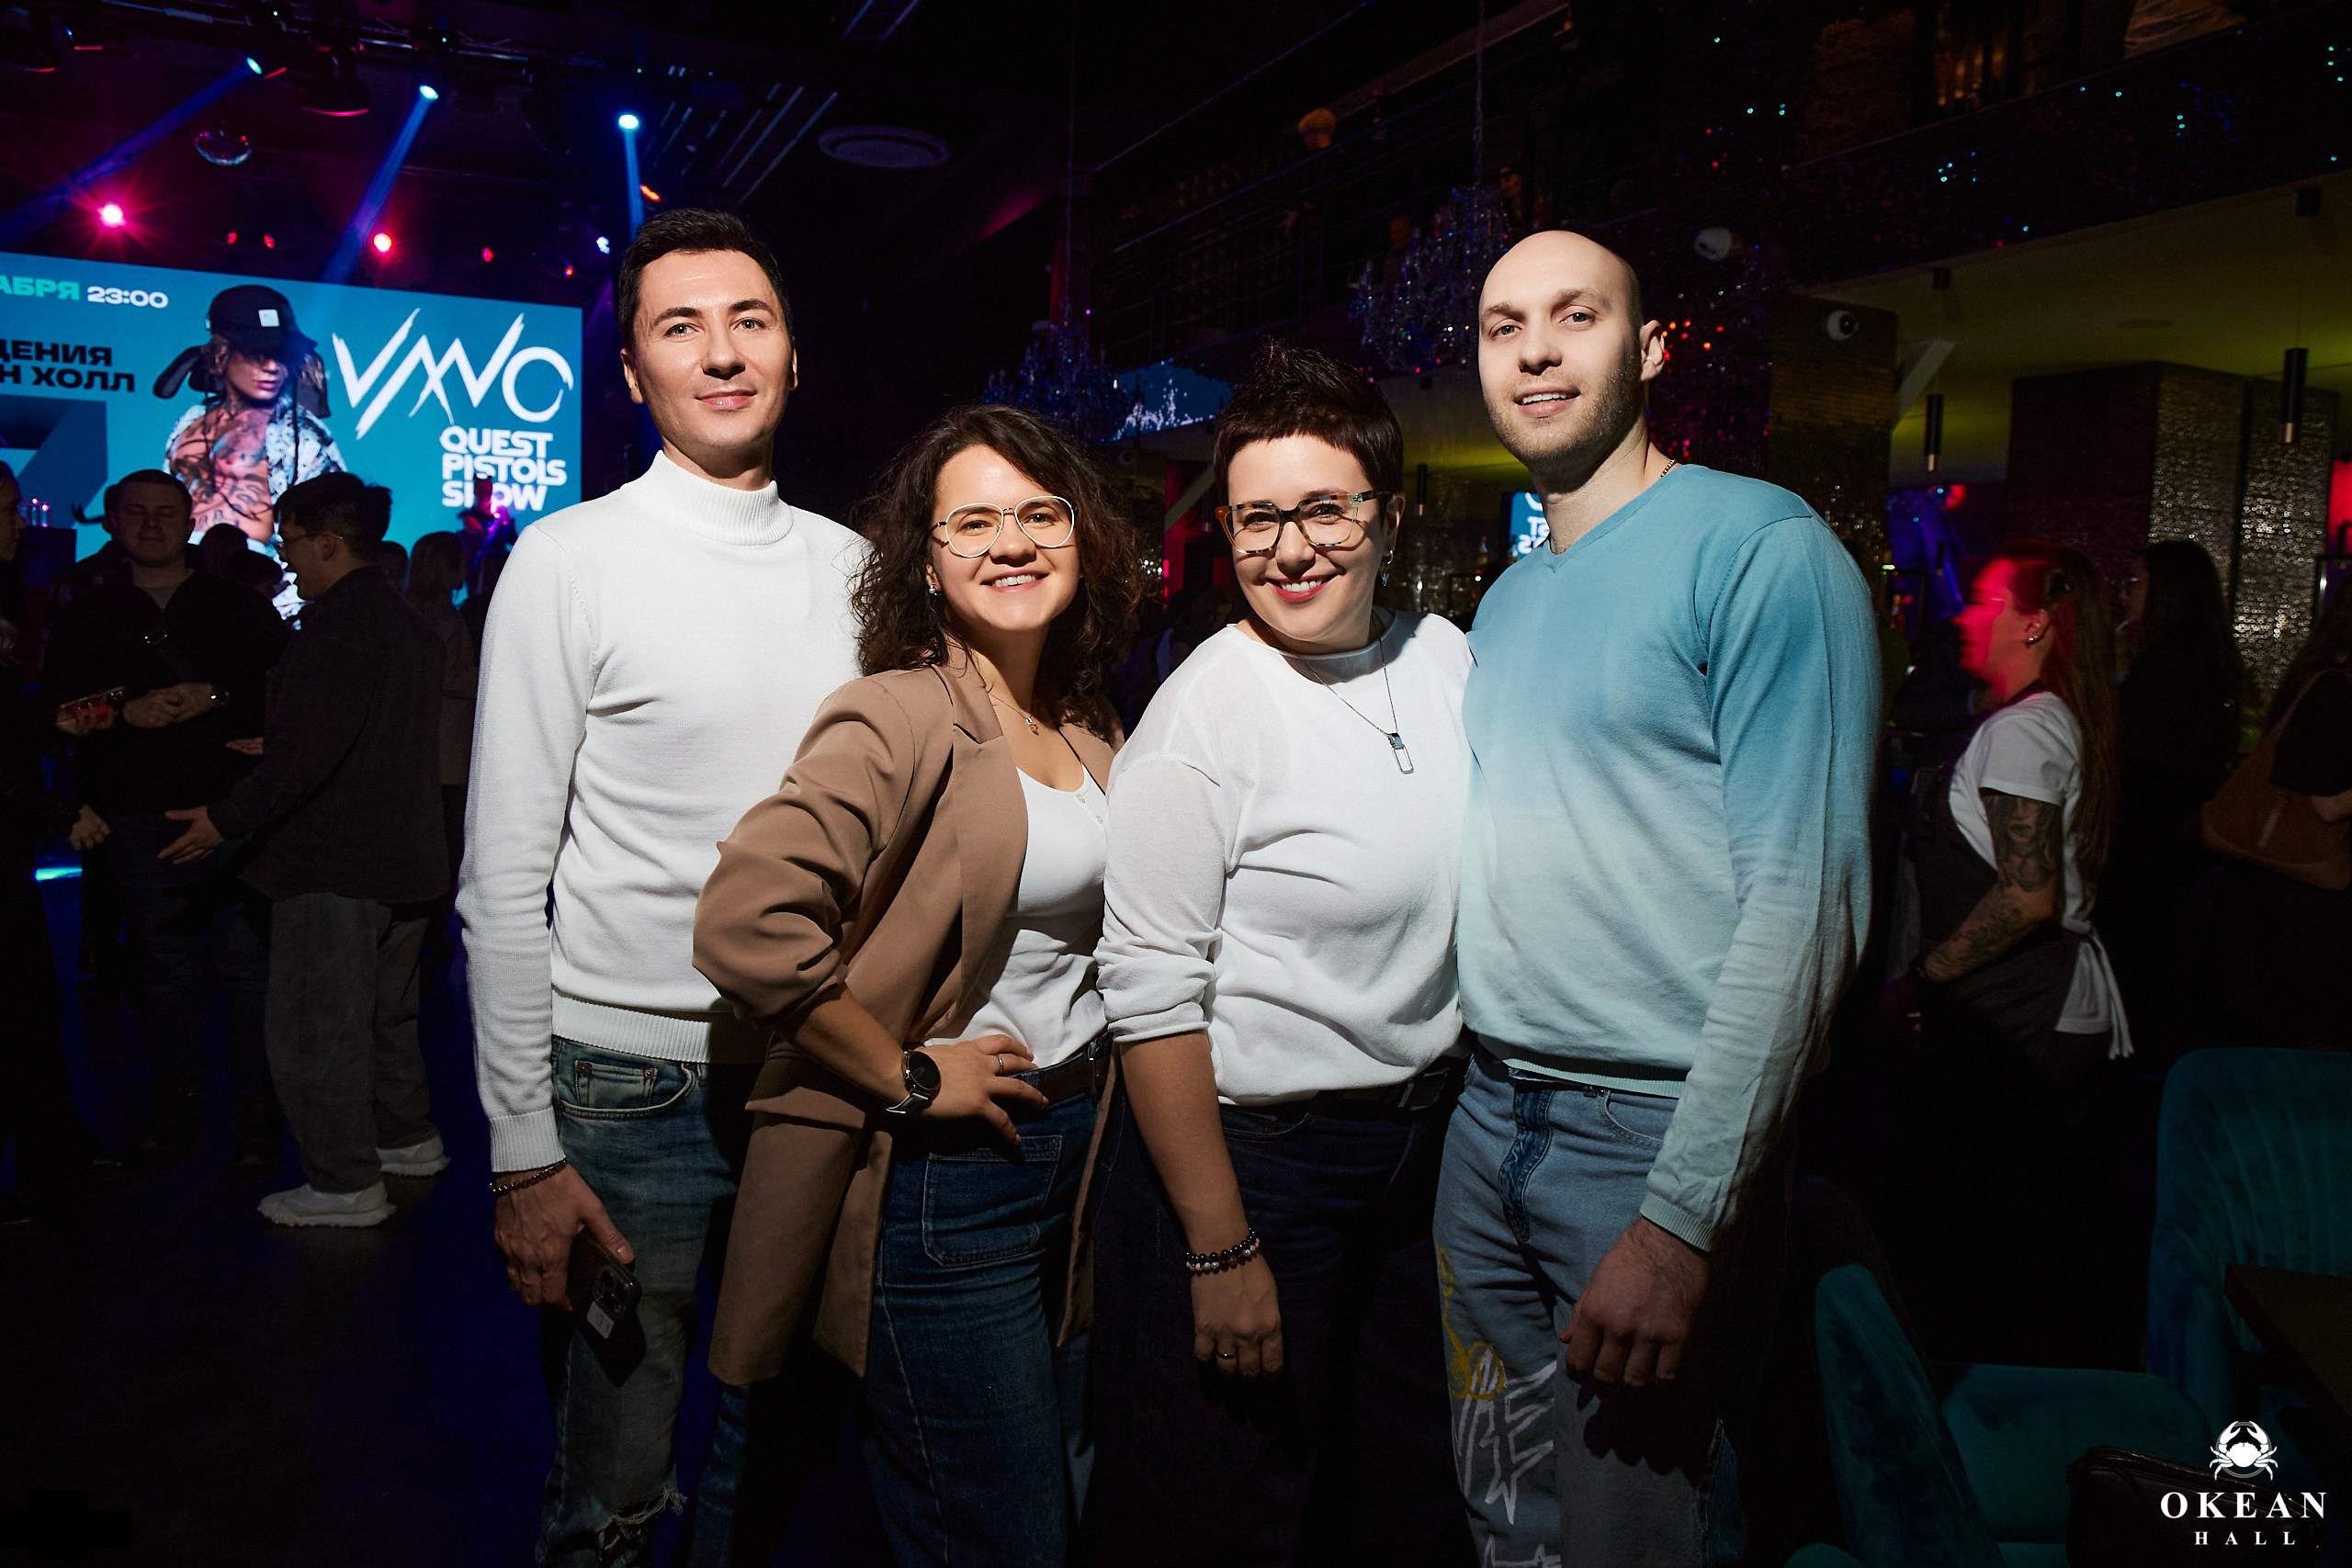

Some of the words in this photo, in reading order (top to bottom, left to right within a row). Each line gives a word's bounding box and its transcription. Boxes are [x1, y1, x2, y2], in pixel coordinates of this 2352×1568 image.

[86, 286, 169, 309] 23:00
[31, 367, 135, 392] ХОЛЛ
[439, 425, 553, 458] QUEST
[442, 453, 568, 486] PISTOLS
